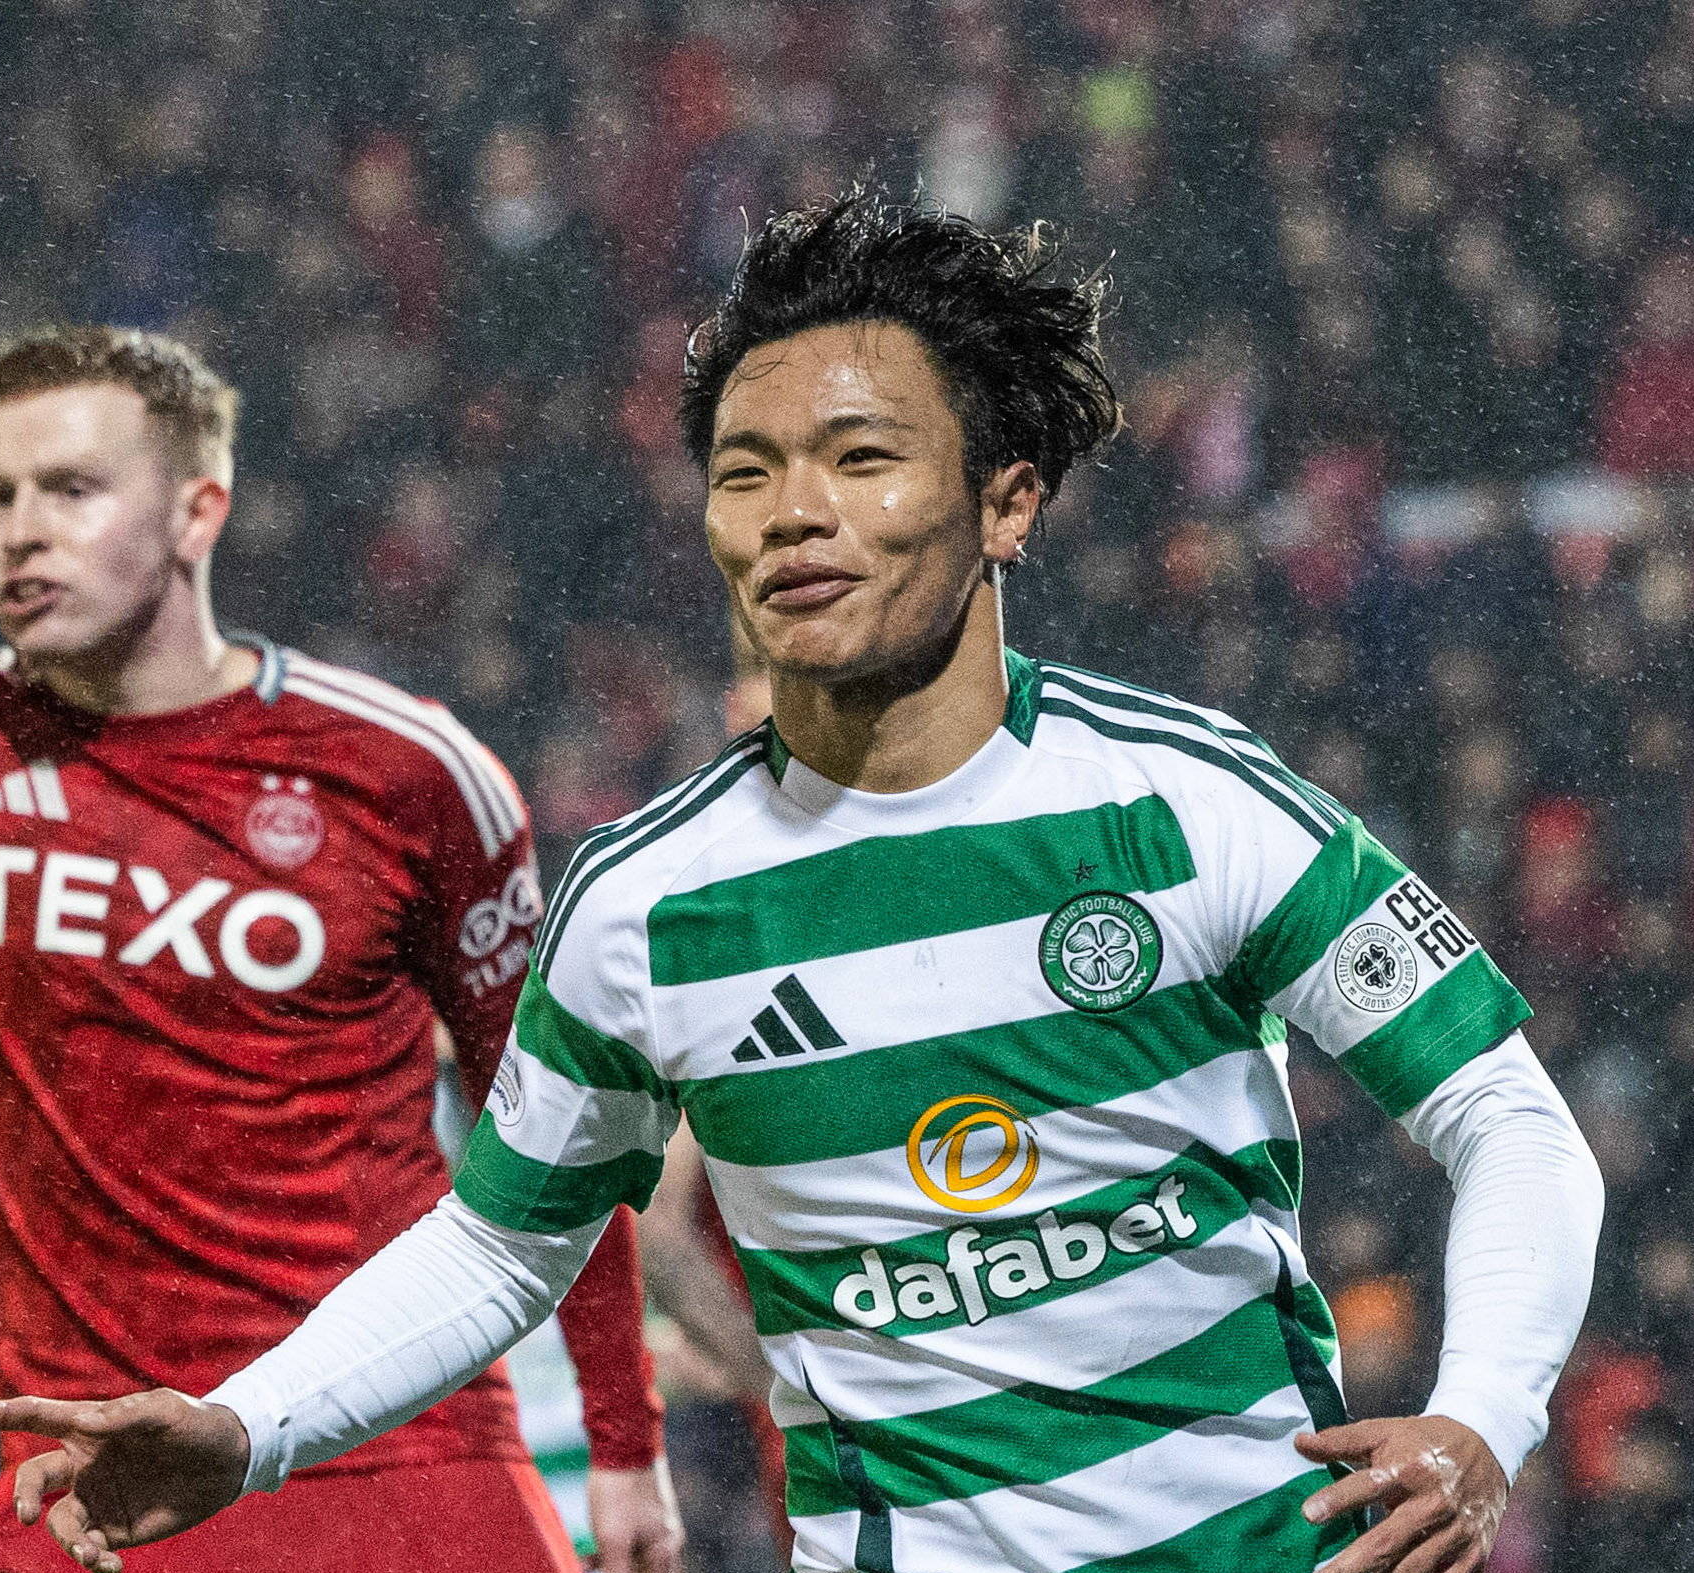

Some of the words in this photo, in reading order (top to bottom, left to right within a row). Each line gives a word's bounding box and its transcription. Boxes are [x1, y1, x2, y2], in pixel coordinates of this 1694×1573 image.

[1079, 897, 1133, 919] FOOTBALL
[1050, 907, 1079, 939] CELTIC
[1133, 915, 1153, 945] CLUB
[1044, 941, 1058, 964] THE
[1339, 955, 1350, 983] CELTIC
[1095, 993, 1122, 1006] 1888
[833, 1175, 1197, 1327] dafabet
